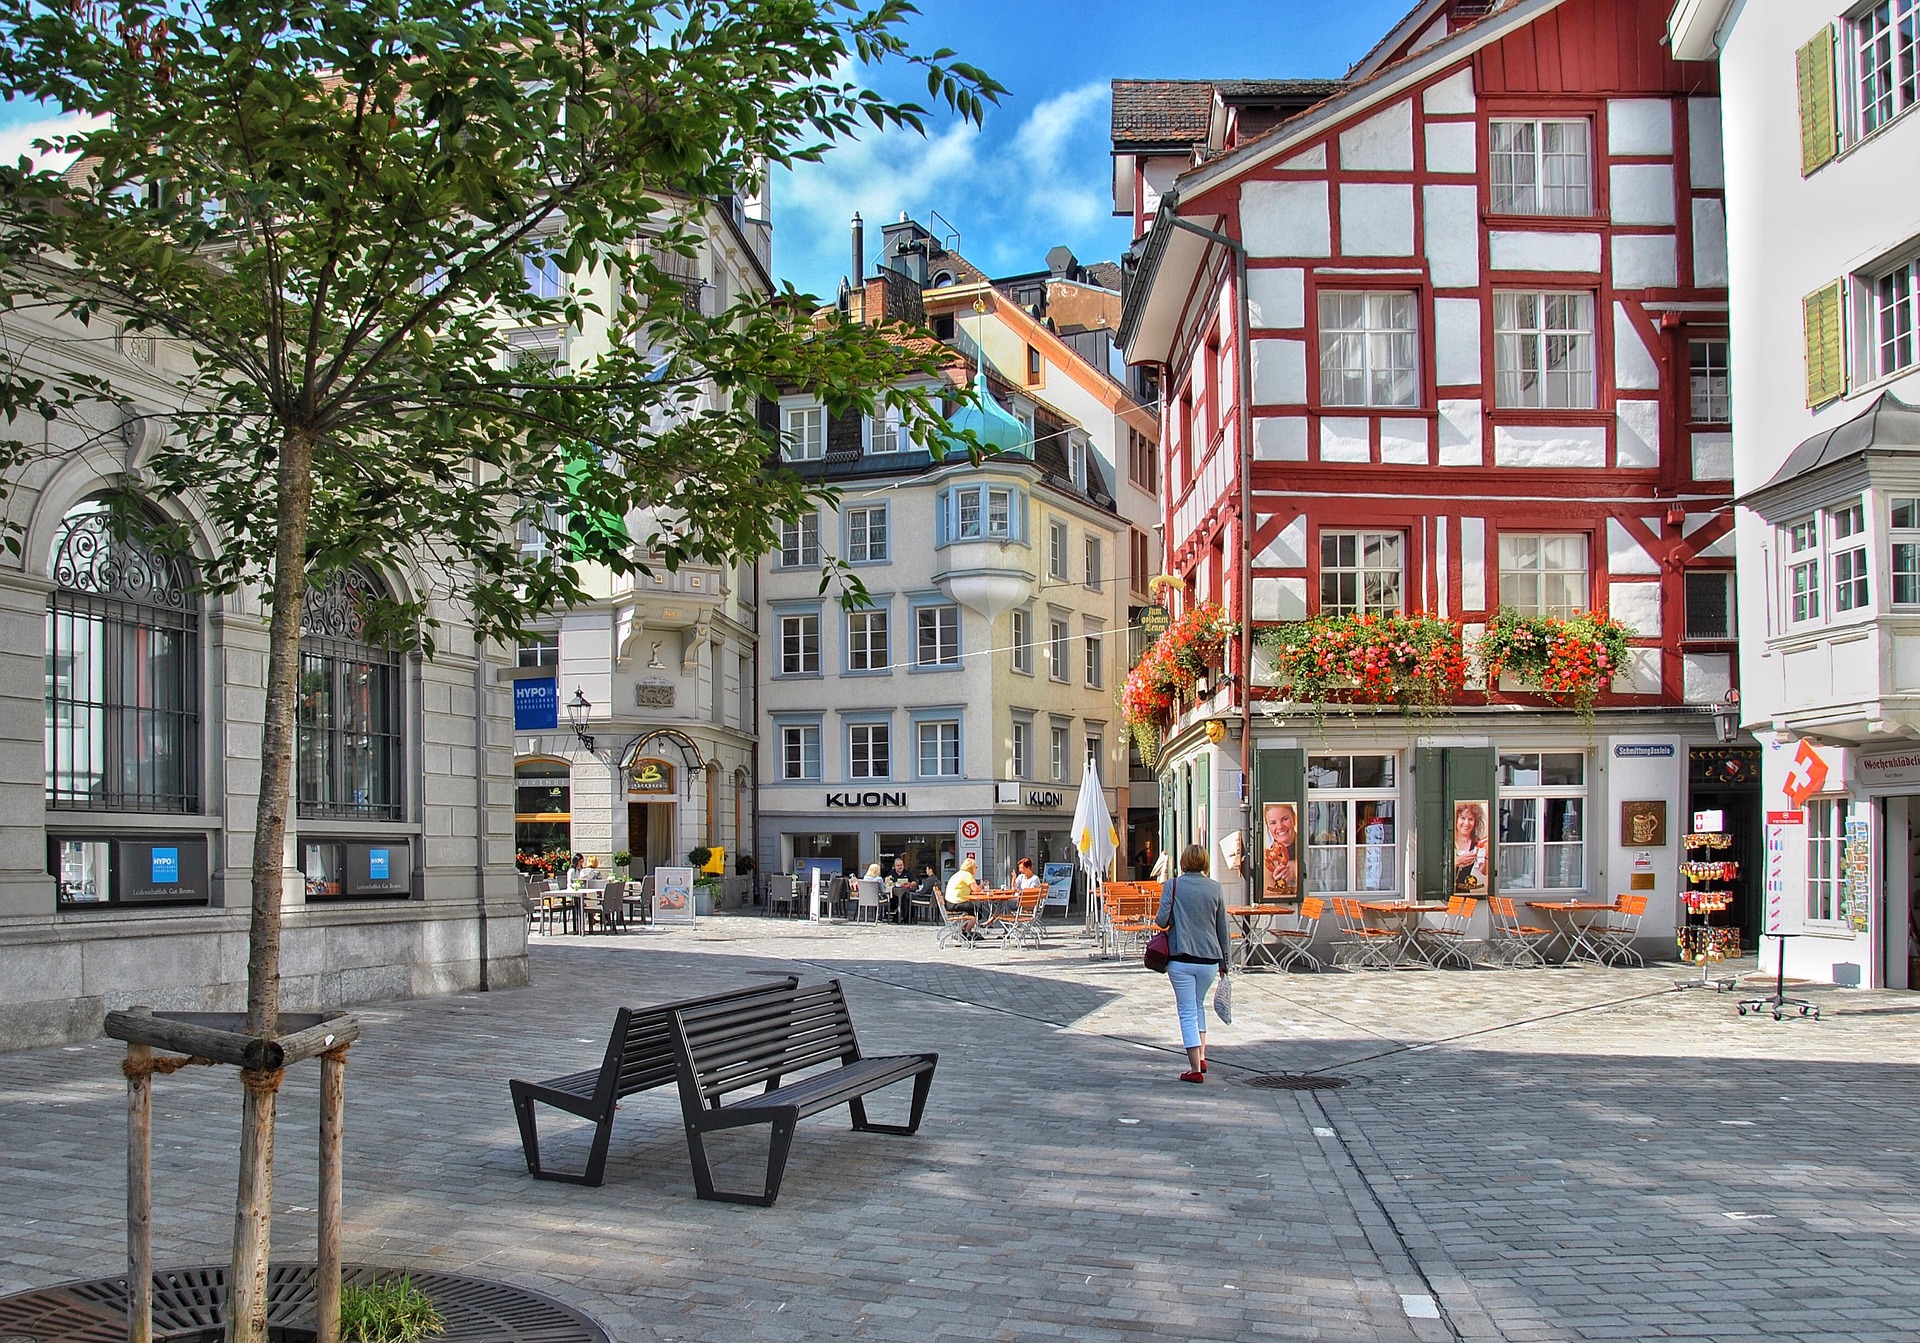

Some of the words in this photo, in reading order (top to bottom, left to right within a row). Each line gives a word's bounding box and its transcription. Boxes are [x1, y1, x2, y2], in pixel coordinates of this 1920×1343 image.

[516, 687, 546, 698] HYPO
[826, 792, 906, 807] KUONI
[1029, 791, 1063, 806] KUONI
